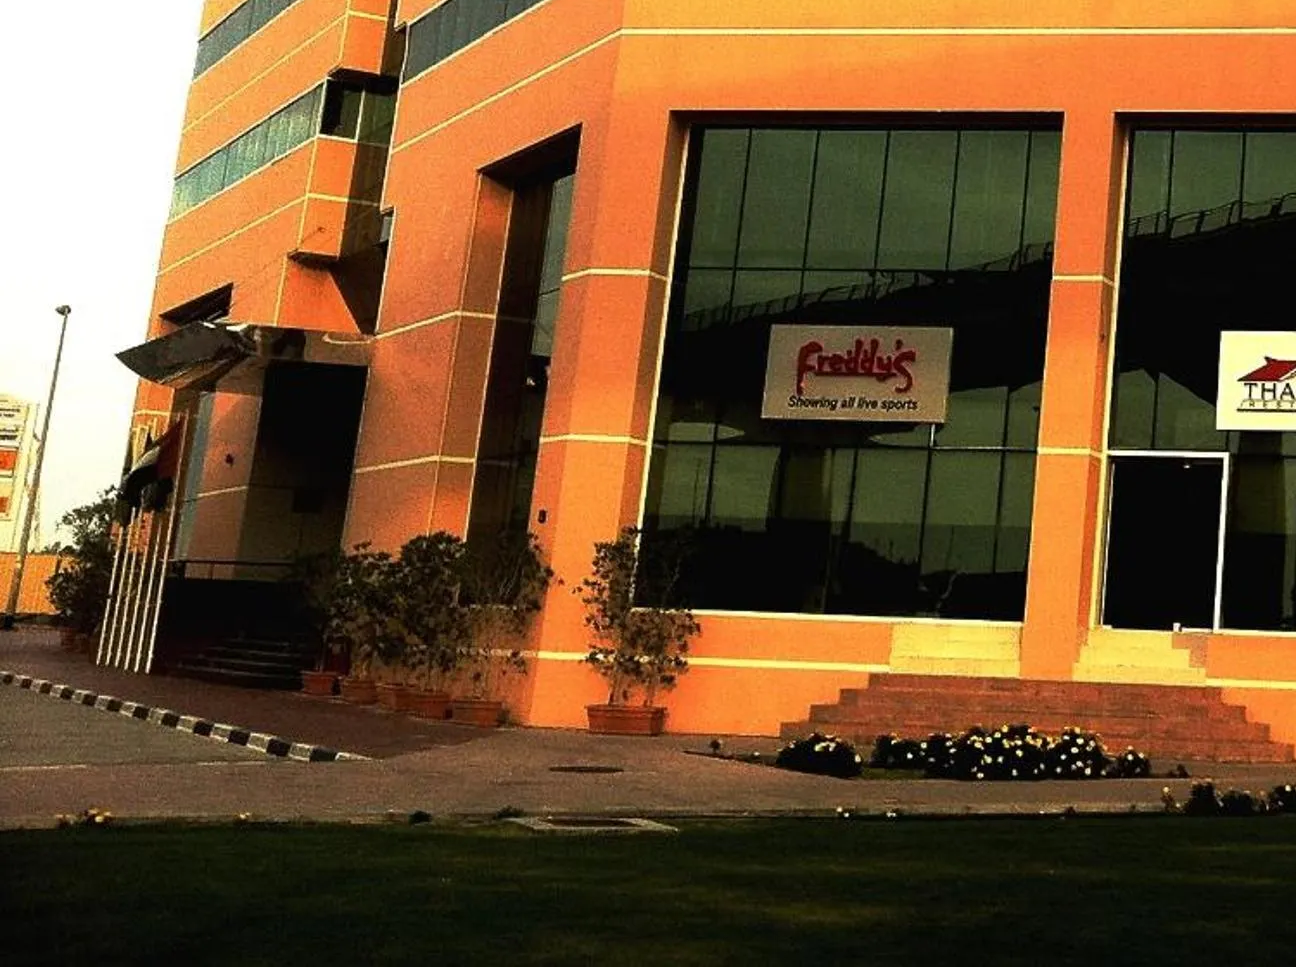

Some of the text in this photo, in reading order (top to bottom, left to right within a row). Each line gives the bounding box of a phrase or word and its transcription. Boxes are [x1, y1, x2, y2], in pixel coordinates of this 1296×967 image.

[796, 339, 916, 396] Freddy's
[787, 395, 918, 412] Showing all live sports
